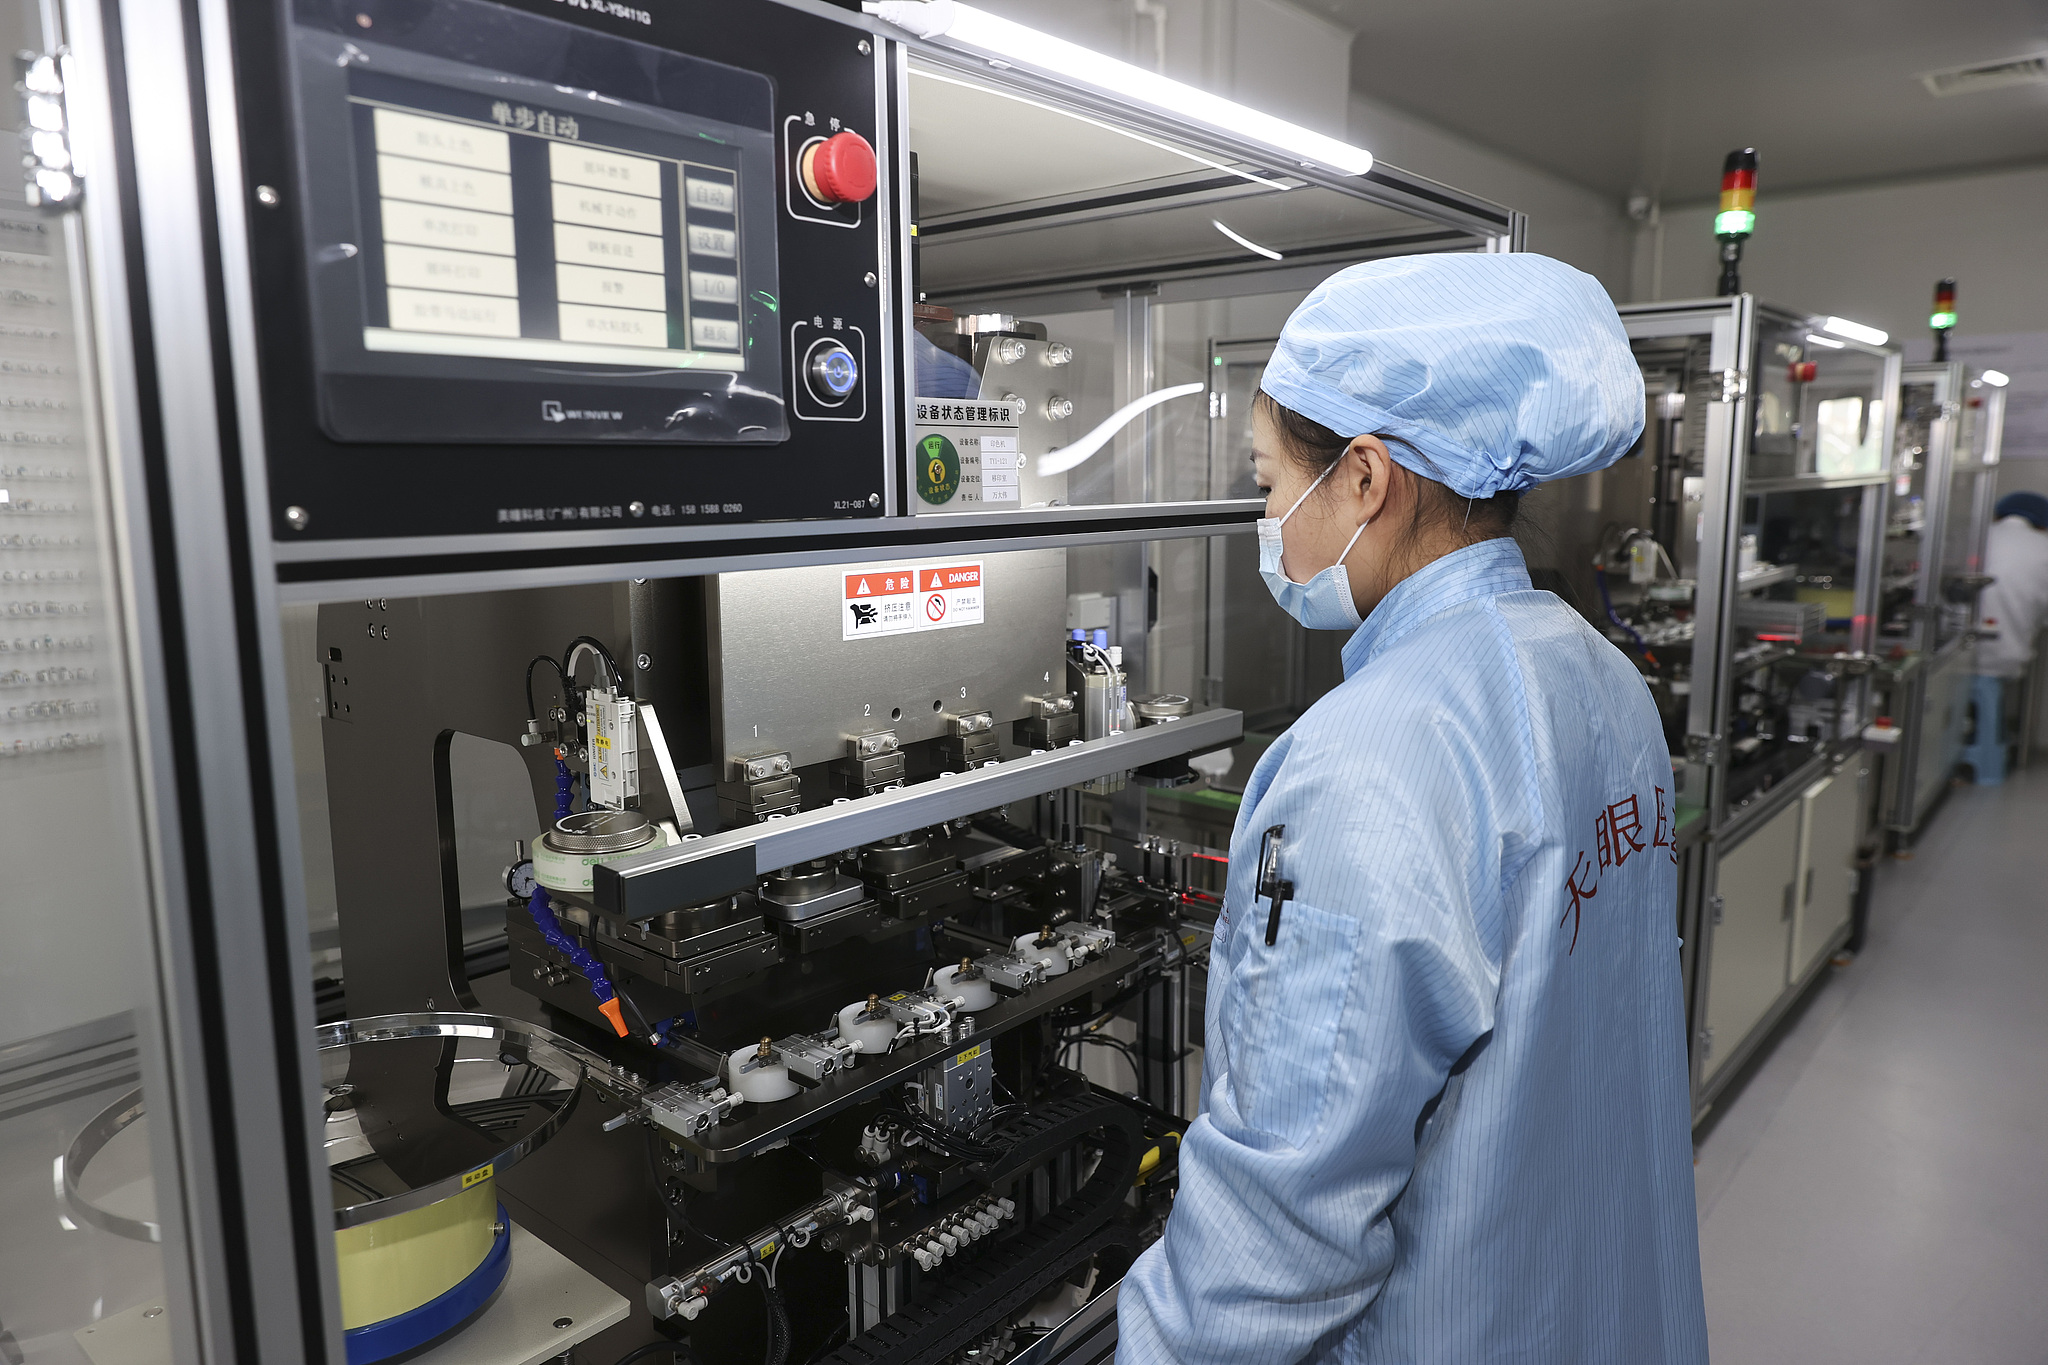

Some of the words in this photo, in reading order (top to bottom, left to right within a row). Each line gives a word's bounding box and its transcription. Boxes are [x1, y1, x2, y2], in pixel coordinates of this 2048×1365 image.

[491, 101, 579, 140] 单步自动
[804, 110, 841, 132] 急停
[695, 185, 726, 206] 自动
[697, 231, 726, 251] 设置
[813, 315, 843, 331] 电源
[702, 325, 728, 342] 翻页
[916, 403, 1010, 422] 设备状态管理标识
[928, 440, 941, 450] 运行
[680, 504, 697, 515] 158
[833, 499, 865, 510] XL21-087
[884, 576, 910, 591] 危险
[948, 570, 979, 584] DANGER
[884, 601, 911, 614] 挤压注意
[1043, 671, 1050, 684] 4
[960, 686, 967, 699] 3
[863, 703, 871, 717] 2
[752, 723, 759, 738] 1
[762, 1245, 775, 1256] 左右
